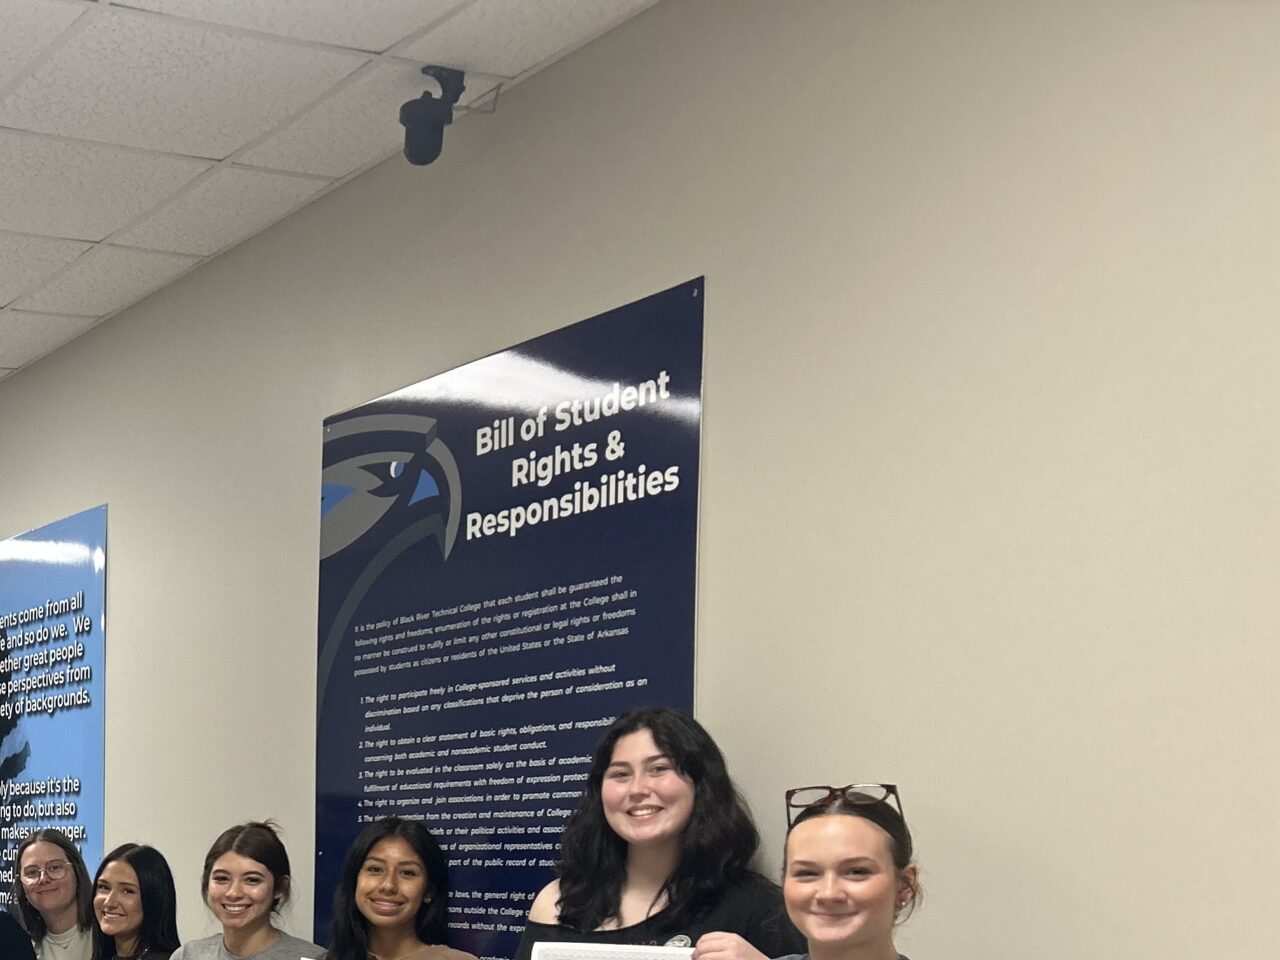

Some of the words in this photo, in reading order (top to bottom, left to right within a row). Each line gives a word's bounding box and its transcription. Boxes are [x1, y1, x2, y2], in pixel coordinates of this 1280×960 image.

[476, 417, 513, 456] Bill
[520, 410, 548, 440] of
[555, 371, 670, 428] Student
[512, 440, 597, 486] Rights
[606, 431, 625, 460] &
[467, 464, 679, 540] Responsibilities
[515, 591, 538, 602] student
[542, 587, 556, 596] shall
[569, 578, 608, 594] guaranteed
[611, 575, 622, 583] the
[18, 608, 44, 623] come
[46, 599, 69, 616] from
[71, 591, 82, 610] all
[522, 605, 558, 618] registration
[584, 596, 609, 606] College
[612, 592, 627, 601] shall
[553, 619, 568, 630] legal
[570, 616, 590, 627] rights
[603, 608, 636, 620] freedoms
[7, 631, 22, 649] and
[24, 631, 34, 645] so
[37, 625, 48, 641] do
[51, 623, 68, 636] we.
[73, 616, 90, 632] We
[522, 641, 541, 650] States
[554, 637, 564, 645] the
[567, 634, 584, 643] State
[587, 631, 594, 640] of
[597, 628, 628, 638] Arkansas
[24, 649, 48, 671] great
[50, 642, 83, 663] people
[8, 671, 64, 694] perspectives
[67, 666, 90, 682] from
[512, 675, 537, 685] services
[540, 672, 553, 681] and
[555, 667, 586, 678] activities
[588, 664, 615, 674] without
[527, 691, 538, 699] the
[540, 688, 563, 698] person
[565, 686, 573, 694] of
[576, 681, 623, 693] consideration
[15, 698, 24, 713] of
[26, 688, 90, 713] backgrounds.
[520, 723, 556, 735] obligations,
[559, 722, 572, 730] and
[520, 741, 546, 749] conduct.
[516, 760, 526, 768] the
[529, 758, 546, 766] basis
[559, 754, 592, 763] academic
[10, 780, 45, 795] because
[48, 776, 61, 792] it's
[63, 776, 79, 792] the
[526, 775, 560, 784] expression
[522, 792, 550, 801] promote
[12, 804, 21, 817] to
[23, 802, 37, 818] do,
[39, 802, 54, 816] but
[56, 799, 75, 815] also
[547, 808, 571, 817] College
[2, 824, 28, 839] makes
[504, 842, 553, 851] representatives
[529, 858, 535, 866] of
[527, 892, 535, 900] of
